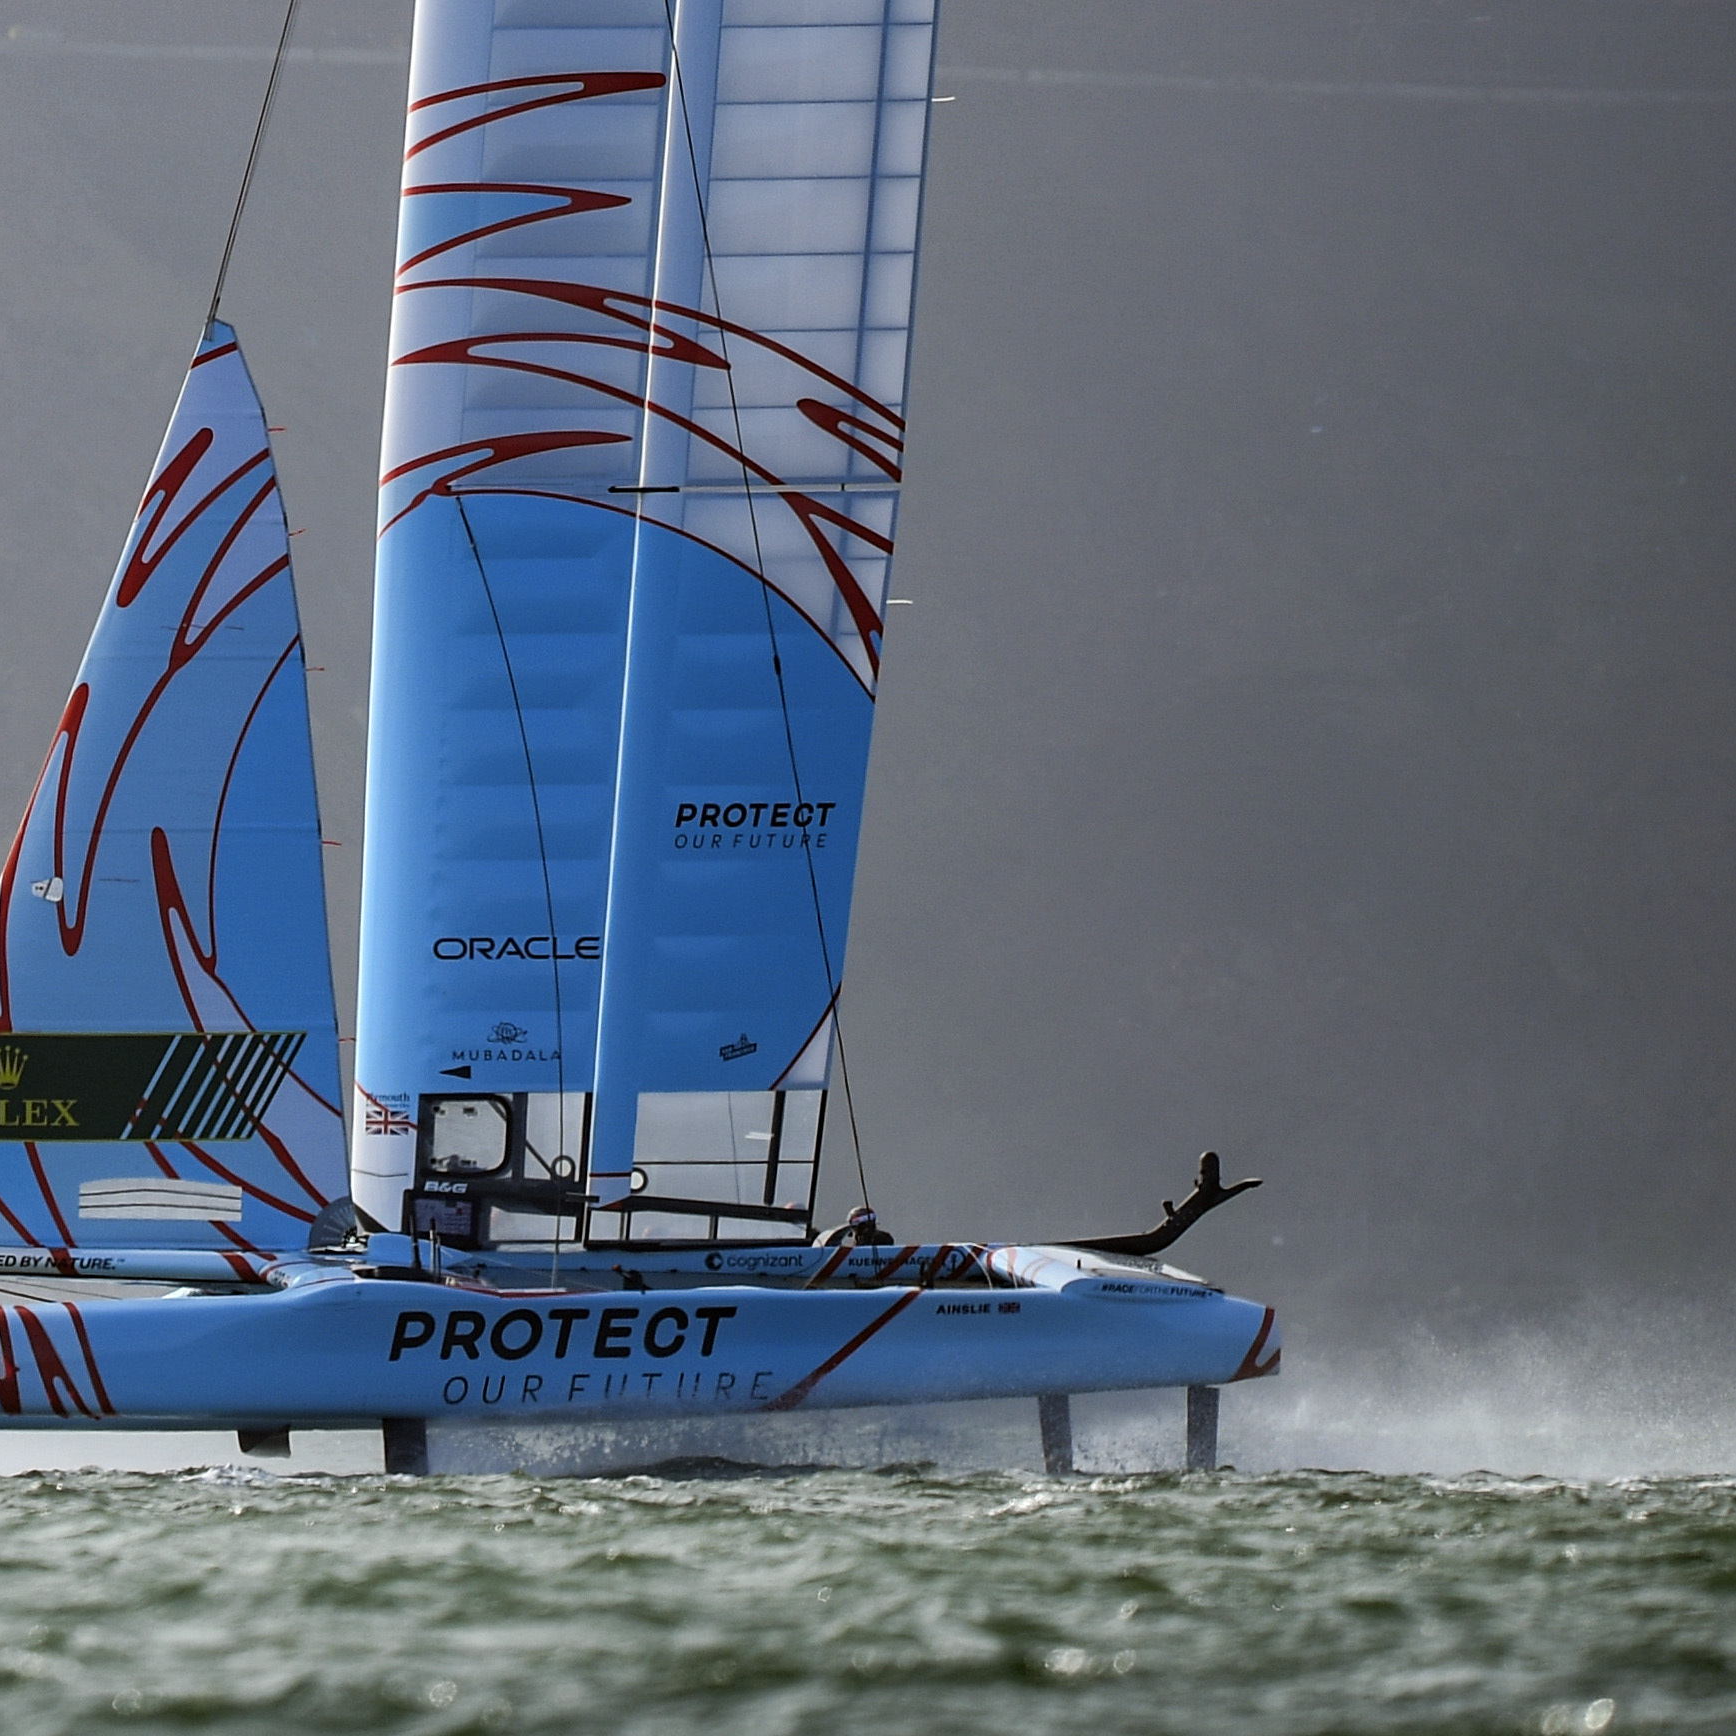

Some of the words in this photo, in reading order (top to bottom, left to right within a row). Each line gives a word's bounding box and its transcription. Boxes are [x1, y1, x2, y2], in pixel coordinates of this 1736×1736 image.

[674, 802, 836, 828] PROTECT
[674, 833, 723, 849] OUR
[732, 833, 828, 849] FUTURE
[432, 936, 601, 961] ORACLE
[451, 1049, 562, 1062] MUBADALA
[423, 1180, 468, 1194] B&G
[20, 1254, 43, 1269] BY
[726, 1253, 803, 1272] cognizant
[936, 1303, 992, 1315] AINSLIE
[388, 1305, 738, 1362] PROTECT
[442, 1373, 544, 1405] OUR
[567, 1369, 774, 1403] FUTURE
